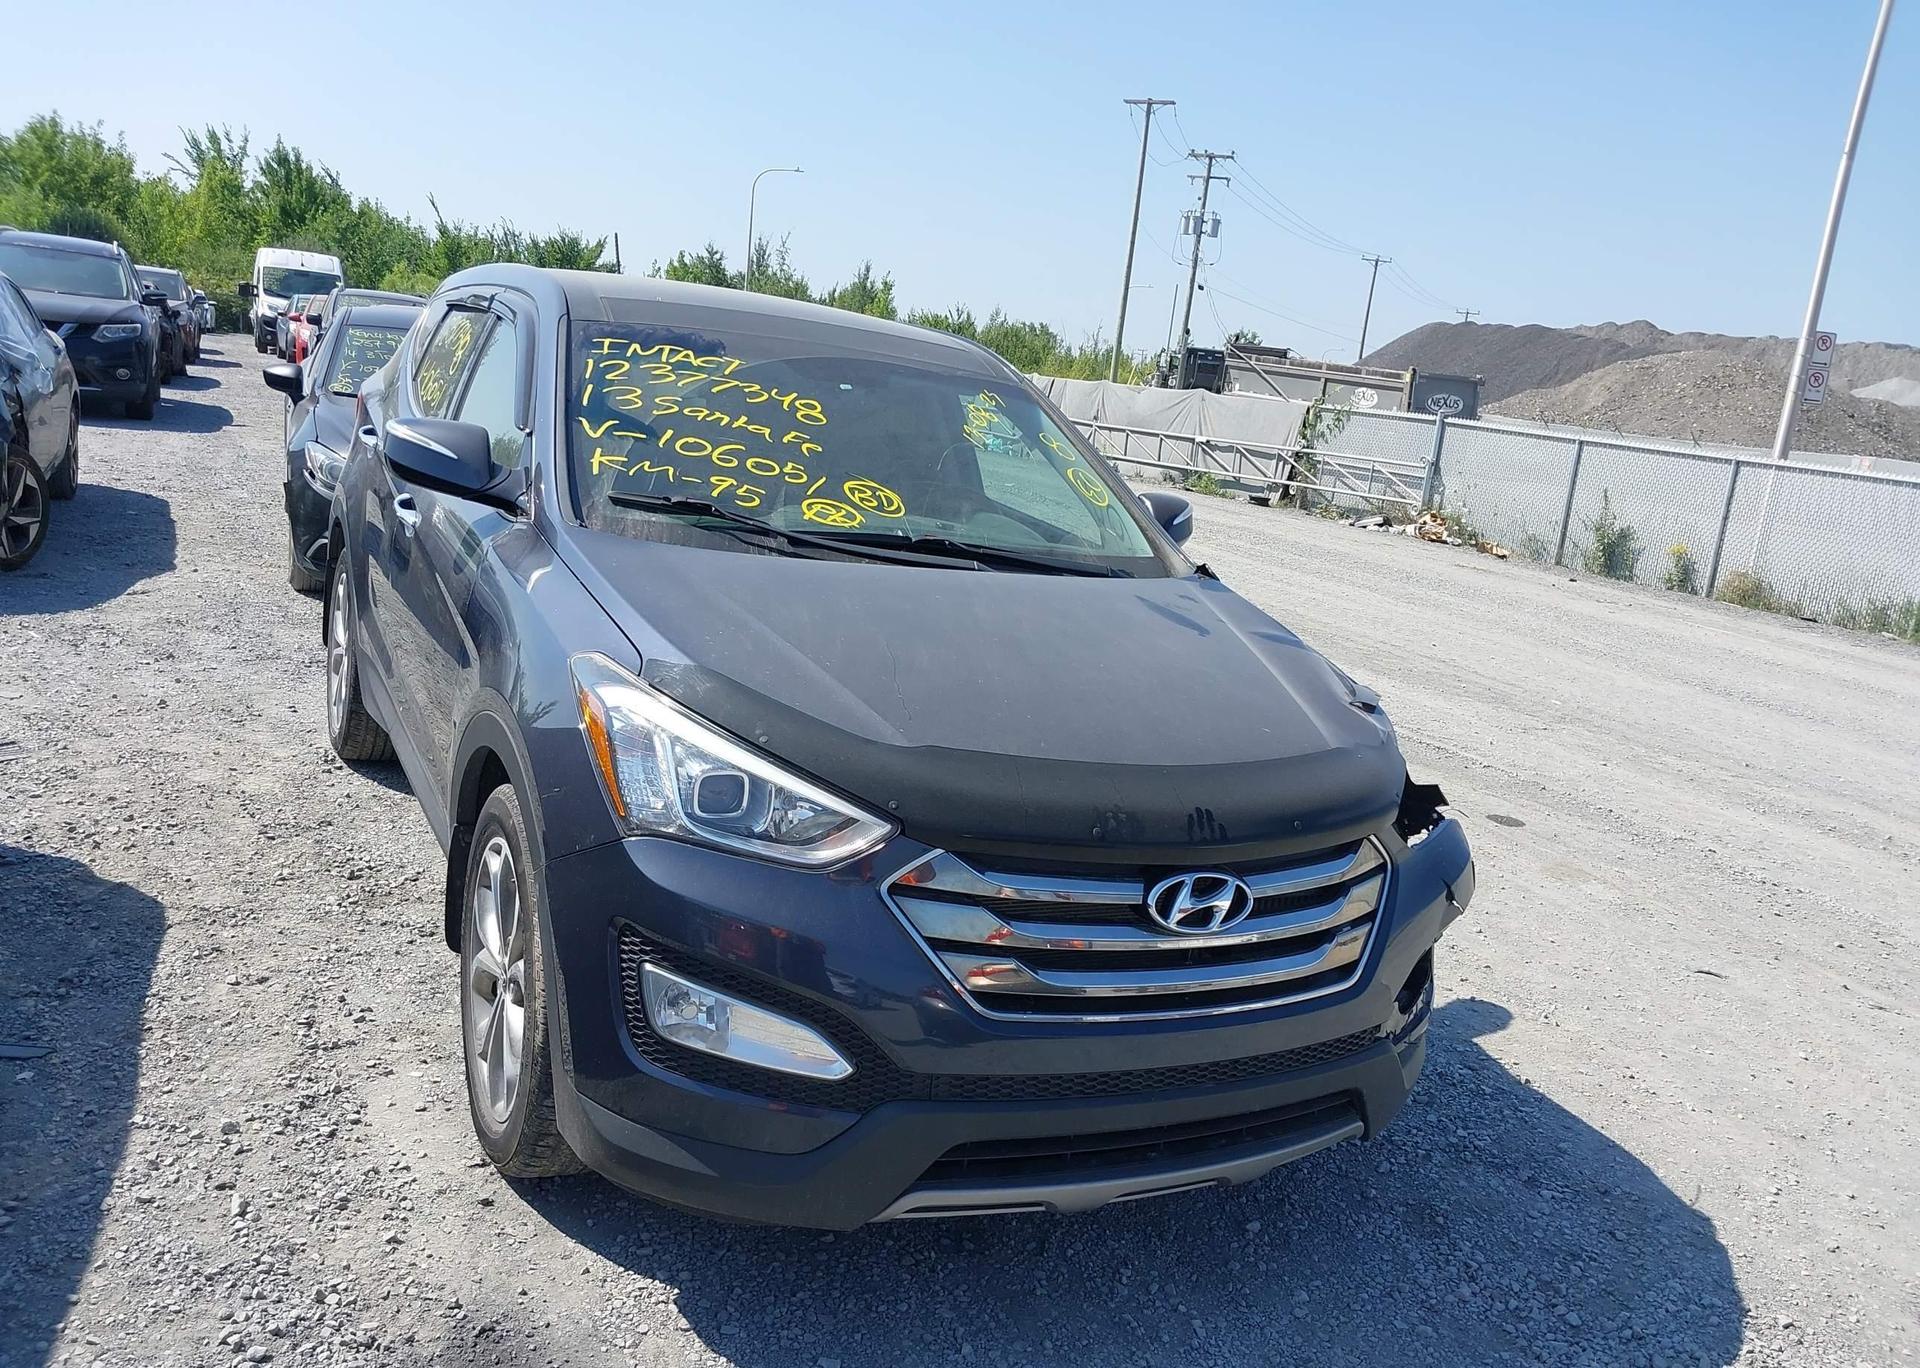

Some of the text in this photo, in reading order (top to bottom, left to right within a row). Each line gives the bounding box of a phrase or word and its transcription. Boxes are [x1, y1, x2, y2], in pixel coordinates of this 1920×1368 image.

[591, 338, 746, 375] INTACT
[582, 384, 643, 410] 13
[585, 358, 828, 426] 12377348
[1430, 394, 1461, 409] NEXUS
[590, 447, 766, 507] KM-95
